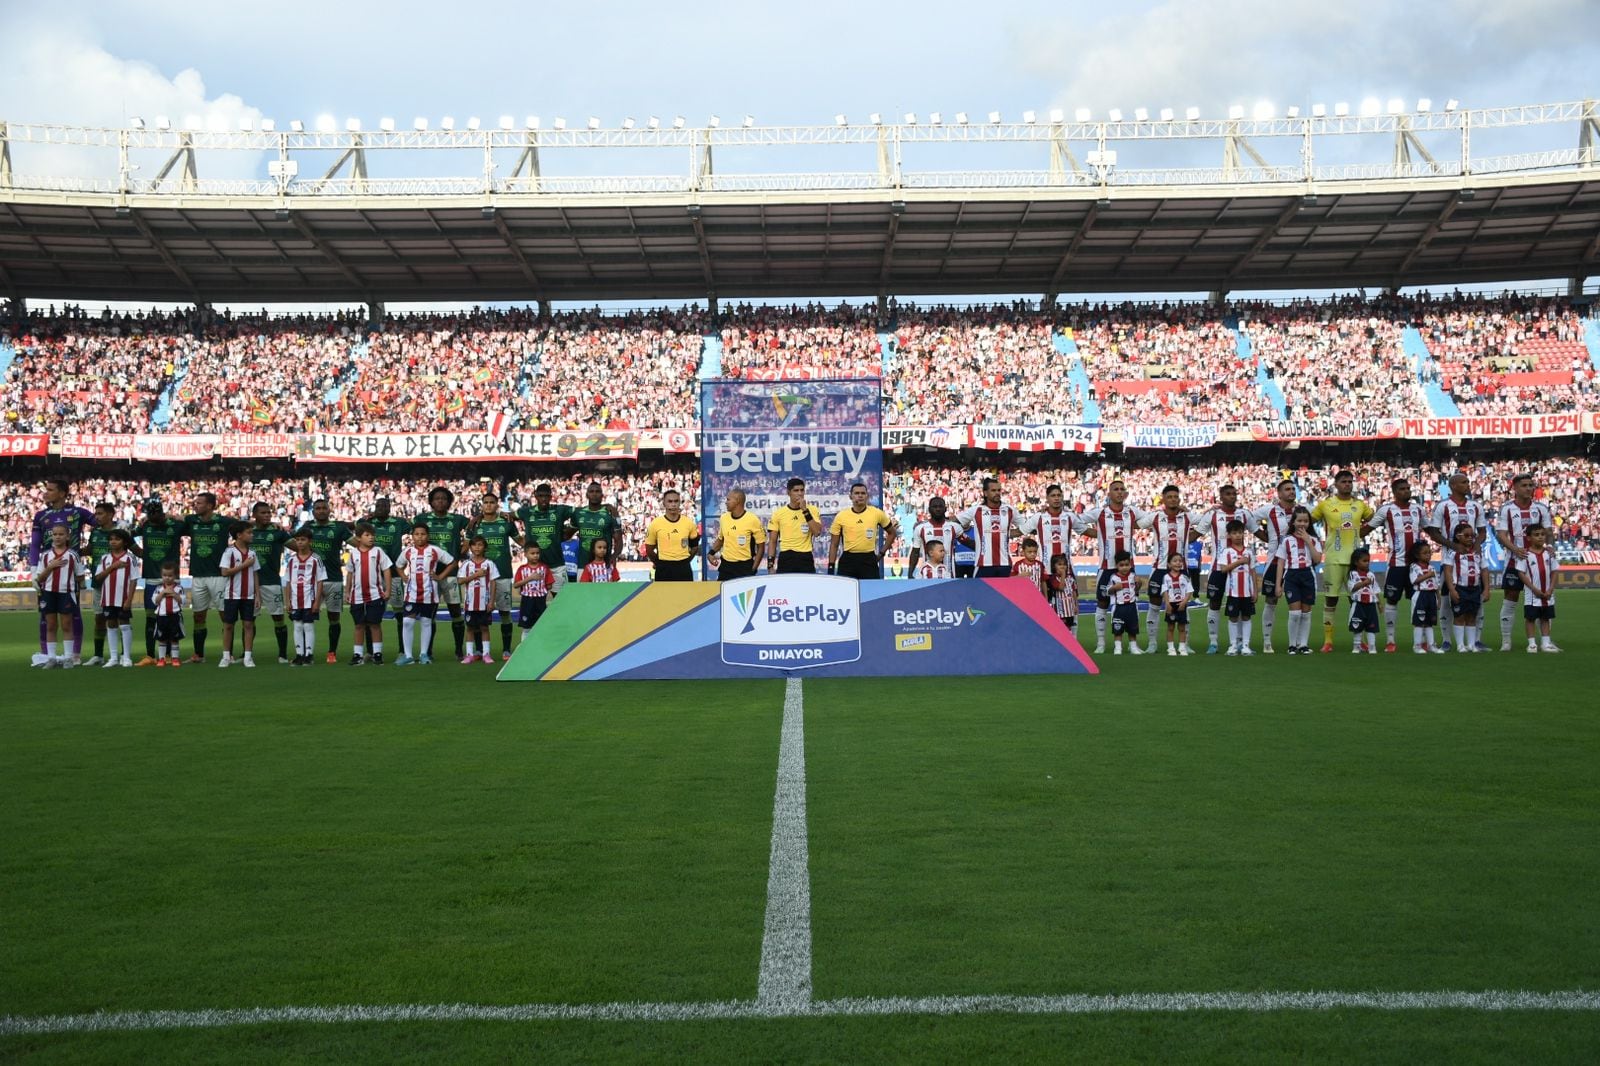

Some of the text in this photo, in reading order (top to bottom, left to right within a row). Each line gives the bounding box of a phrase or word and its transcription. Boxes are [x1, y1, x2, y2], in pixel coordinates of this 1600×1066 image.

[1139, 425, 1216, 436] JUNIORISTAS
[1266, 419, 1378, 437] EL CLUB DEL BARRIO 1924
[1405, 415, 1578, 436] MI SENTIMIENTO 1924
[238, 433, 289, 444] CUESTION
[882, 429, 926, 445] 1924
[976, 427, 1093, 441] JUNIORMANIA 1924
[151, 441, 200, 457] KOALICION
[222, 445, 288, 456] DE CORAZON
[405, 435, 445, 457] DEL
[449, 434, 553, 456] AGUANTE
[557, 432, 635, 458] 924
[714, 439, 868, 480] BetPlay
[767, 598, 789, 606] LIGA
[767, 603, 852, 626] BetPlay
[893, 607, 965, 627] BetPlay
[759, 648, 824, 661] DIMAYOR
